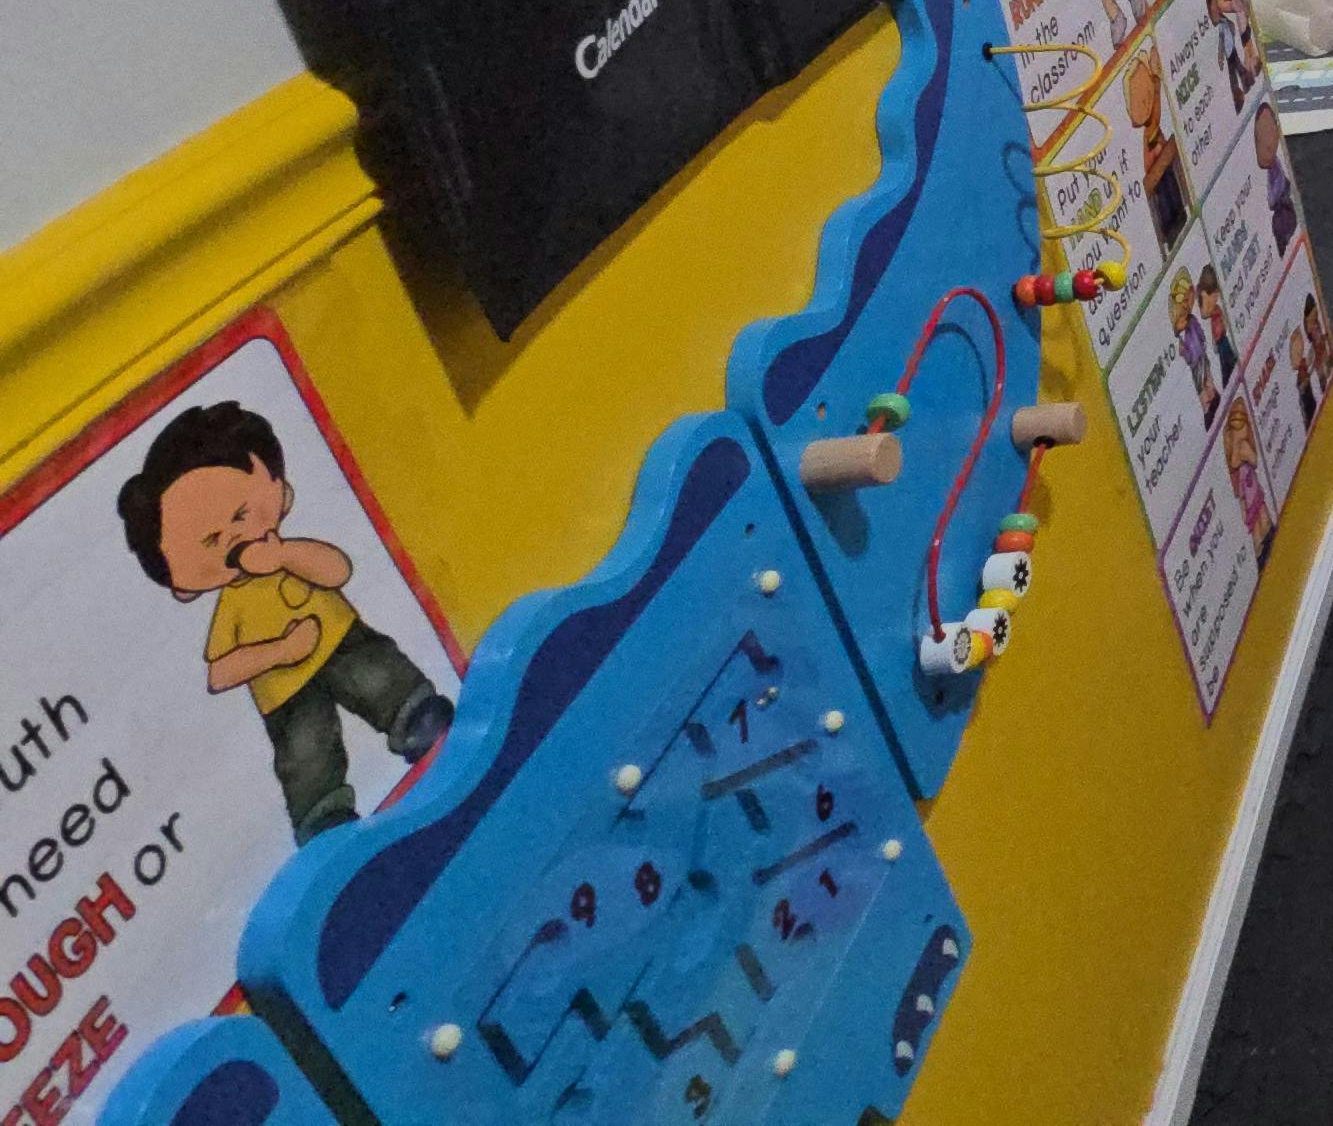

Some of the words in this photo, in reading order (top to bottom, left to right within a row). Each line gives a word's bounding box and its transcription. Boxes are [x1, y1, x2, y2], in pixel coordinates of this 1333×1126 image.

[1035, 15, 1059, 48] the
[1168, 30, 1202, 78] Always
[1057, 180, 1082, 212] Put
[1128, 179, 1142, 203] to
[1097, 261, 1147, 348] question
[1136, 413, 1162, 470] your
[1145, 414, 1184, 495] teacher
[0, 756, 132, 918] need
[134, 811, 184, 886] or
